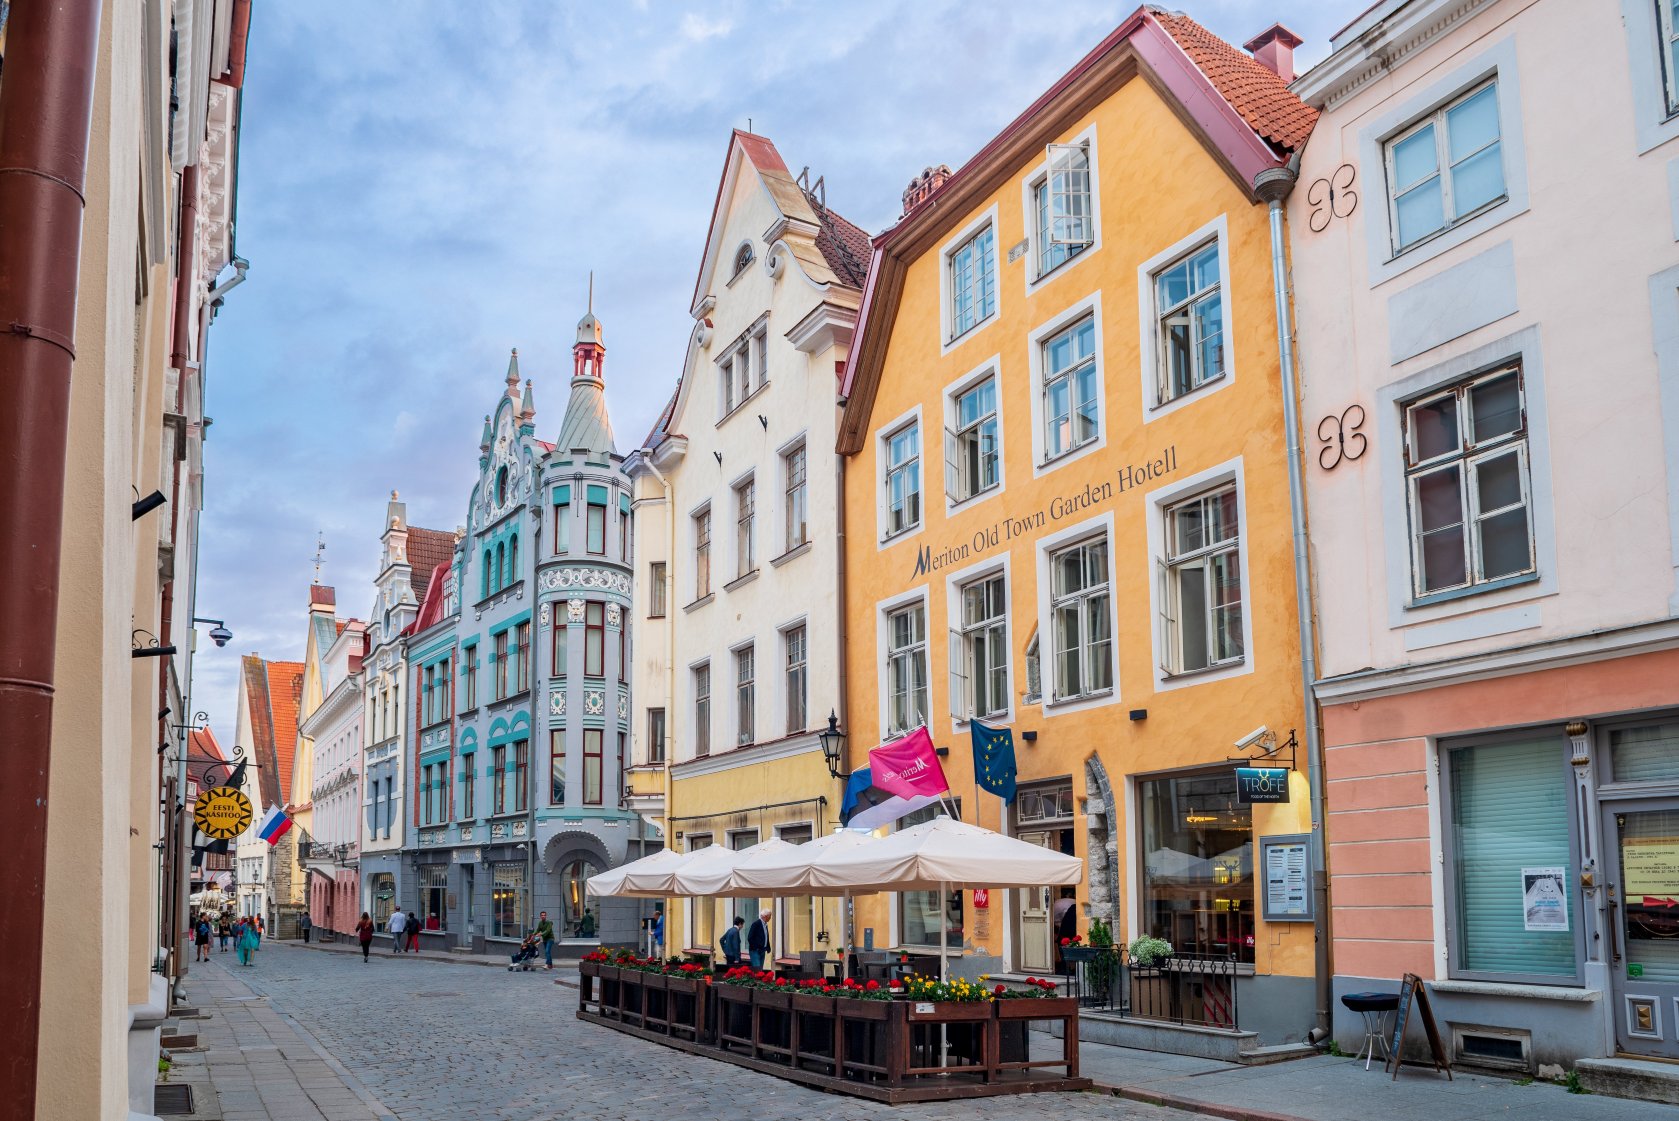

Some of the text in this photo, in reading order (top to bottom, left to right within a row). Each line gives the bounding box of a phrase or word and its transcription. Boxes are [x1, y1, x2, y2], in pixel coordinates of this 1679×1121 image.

[909, 445, 1178, 582] Meriton Old Town Garden Hotell
[1242, 775, 1285, 792] TROFÉ
[975, 889, 987, 906] illy
